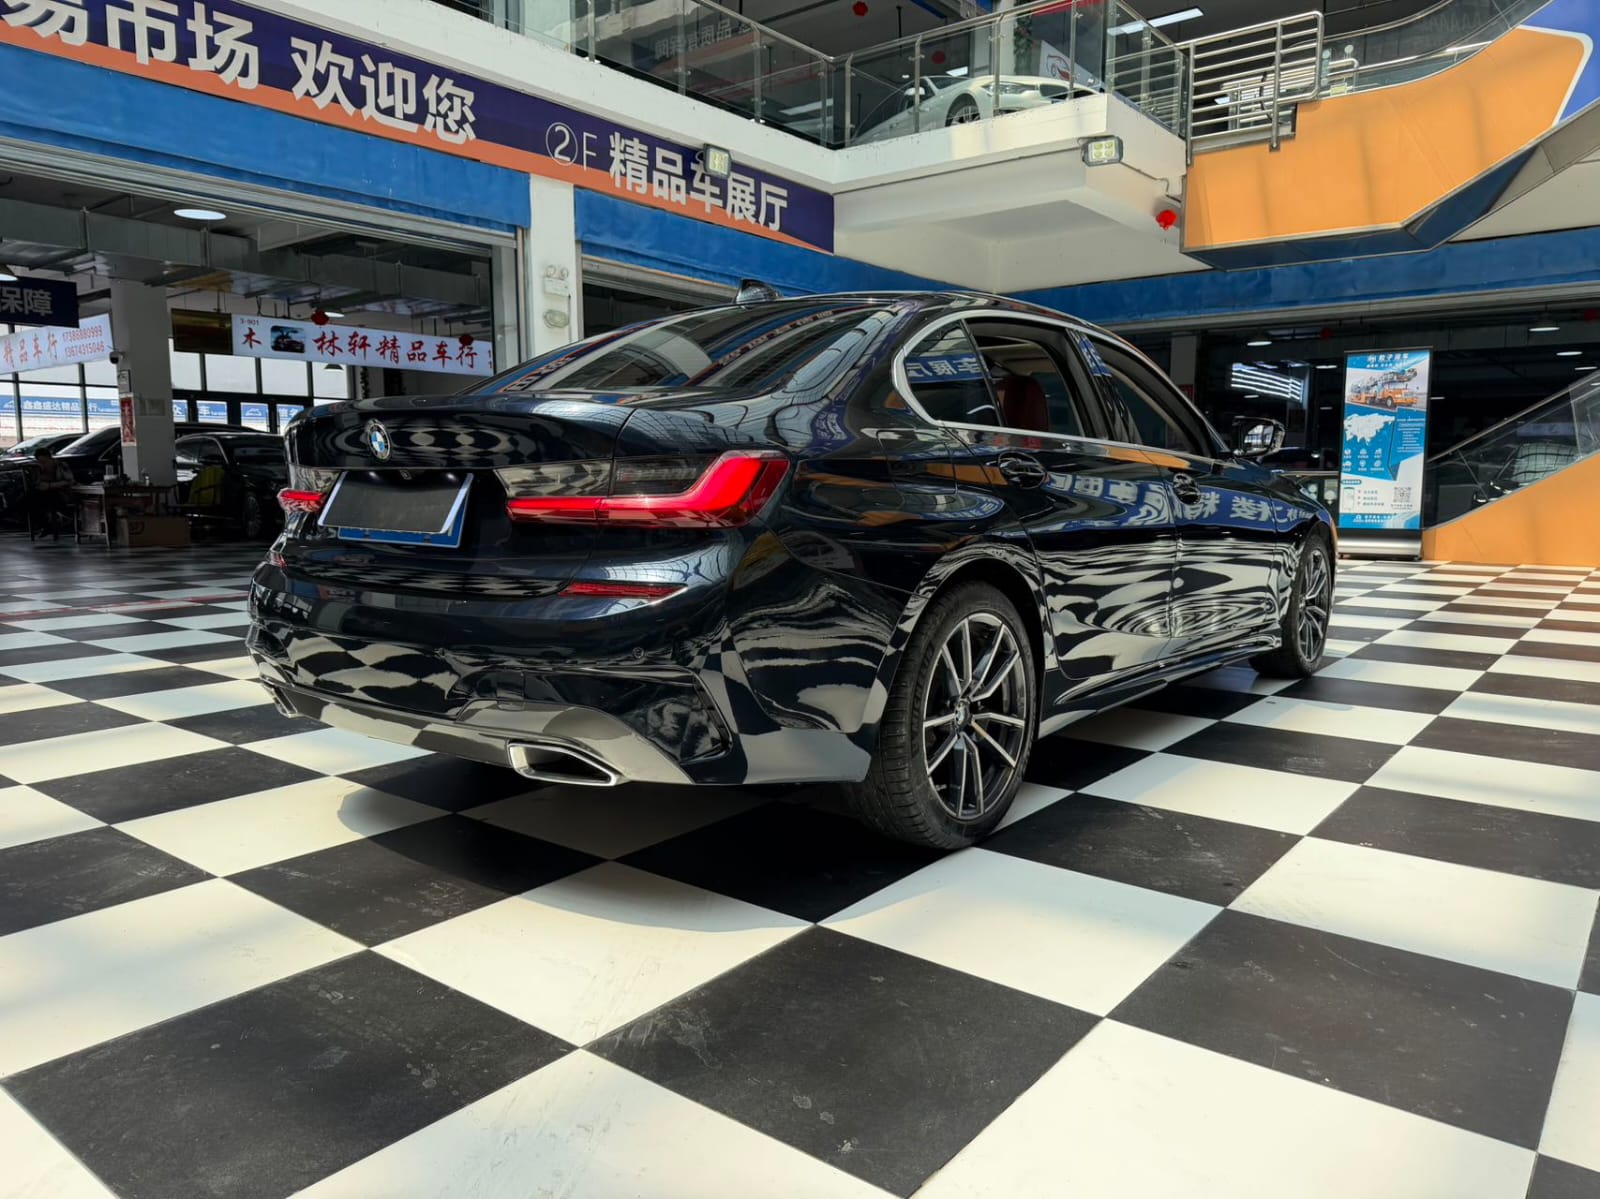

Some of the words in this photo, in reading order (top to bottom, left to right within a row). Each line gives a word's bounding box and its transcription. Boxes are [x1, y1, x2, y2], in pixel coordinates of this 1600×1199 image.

[291, 36, 477, 145] 欢迎您
[609, 132, 788, 231] 精品车展厅
[241, 327, 262, 350] 木
[312, 330, 478, 369] 林轩精品车行
